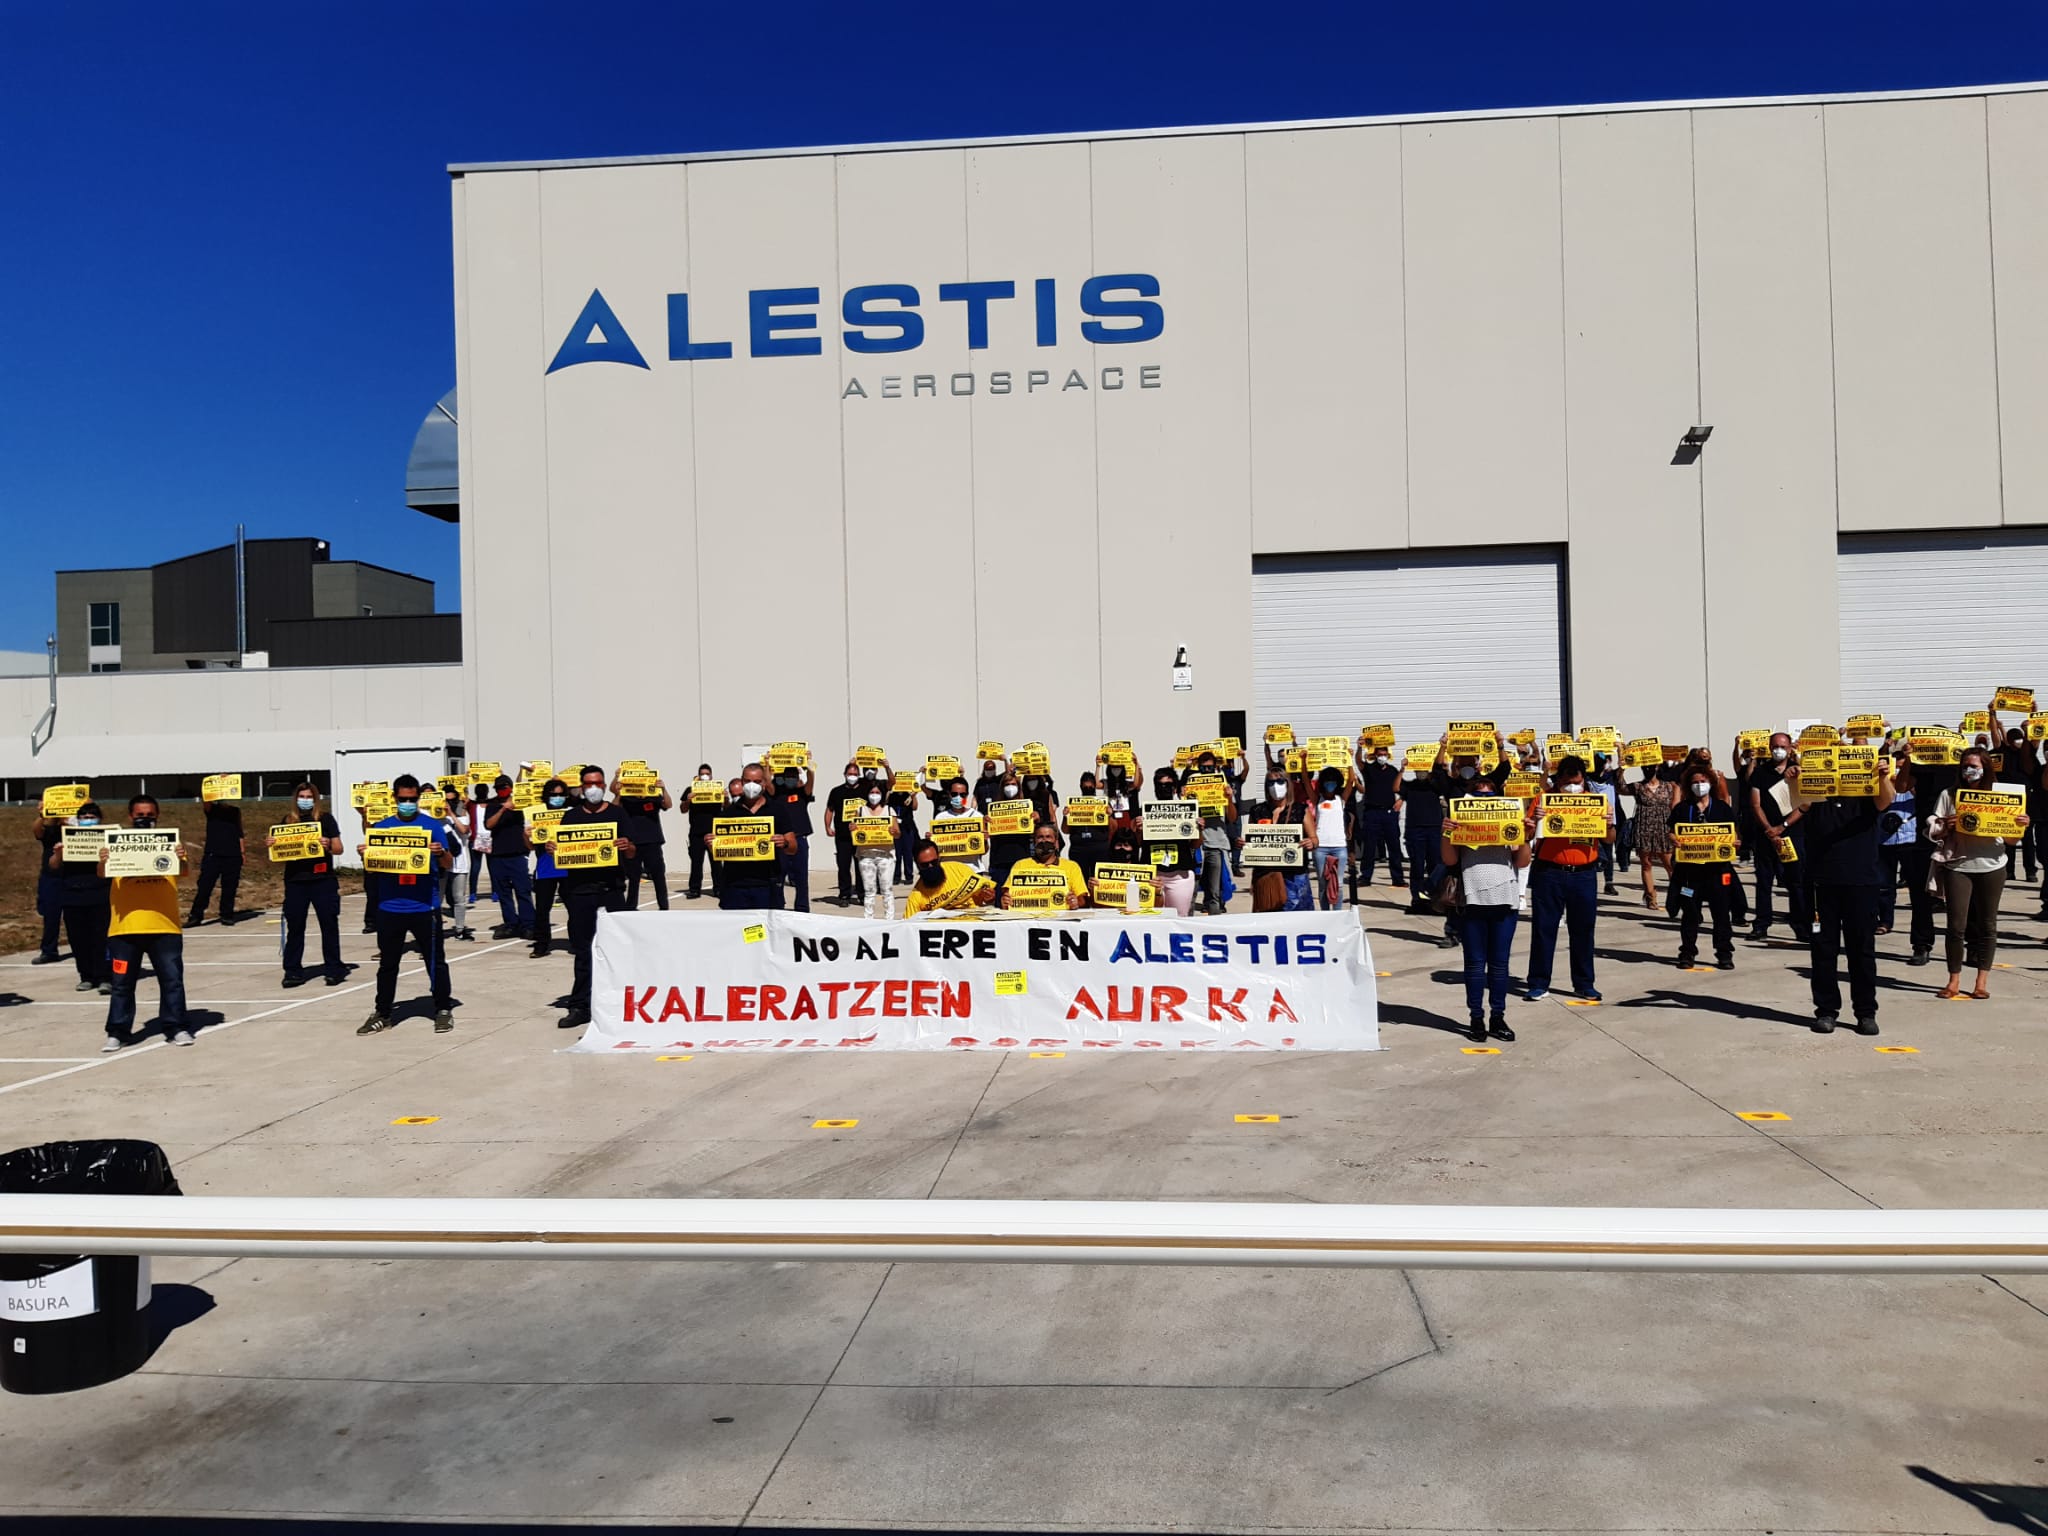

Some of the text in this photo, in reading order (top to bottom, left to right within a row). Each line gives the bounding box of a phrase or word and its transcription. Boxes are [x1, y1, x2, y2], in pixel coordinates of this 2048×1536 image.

[545, 273, 1165, 376] ALESTIS
[841, 365, 1162, 399] AEROSPACE
[1549, 796, 1601, 806] ALESTISen
[1963, 793, 2020, 805] ALESTISen
[729, 824, 769, 834] ALESTIS
[116, 834, 169, 843] ALESTISen
[570, 830, 612, 840] ALESTIS
[383, 836, 426, 846] ALESTIS
[1024, 876, 1064, 885] ALESTIS
[793, 928, 1339, 965] NO AL ERE EN ALESTIS.
[623, 980, 971, 1023] KALERATZEEN
[27, 1278, 47, 1289] DE
[8, 1296, 69, 1311] BASURA
